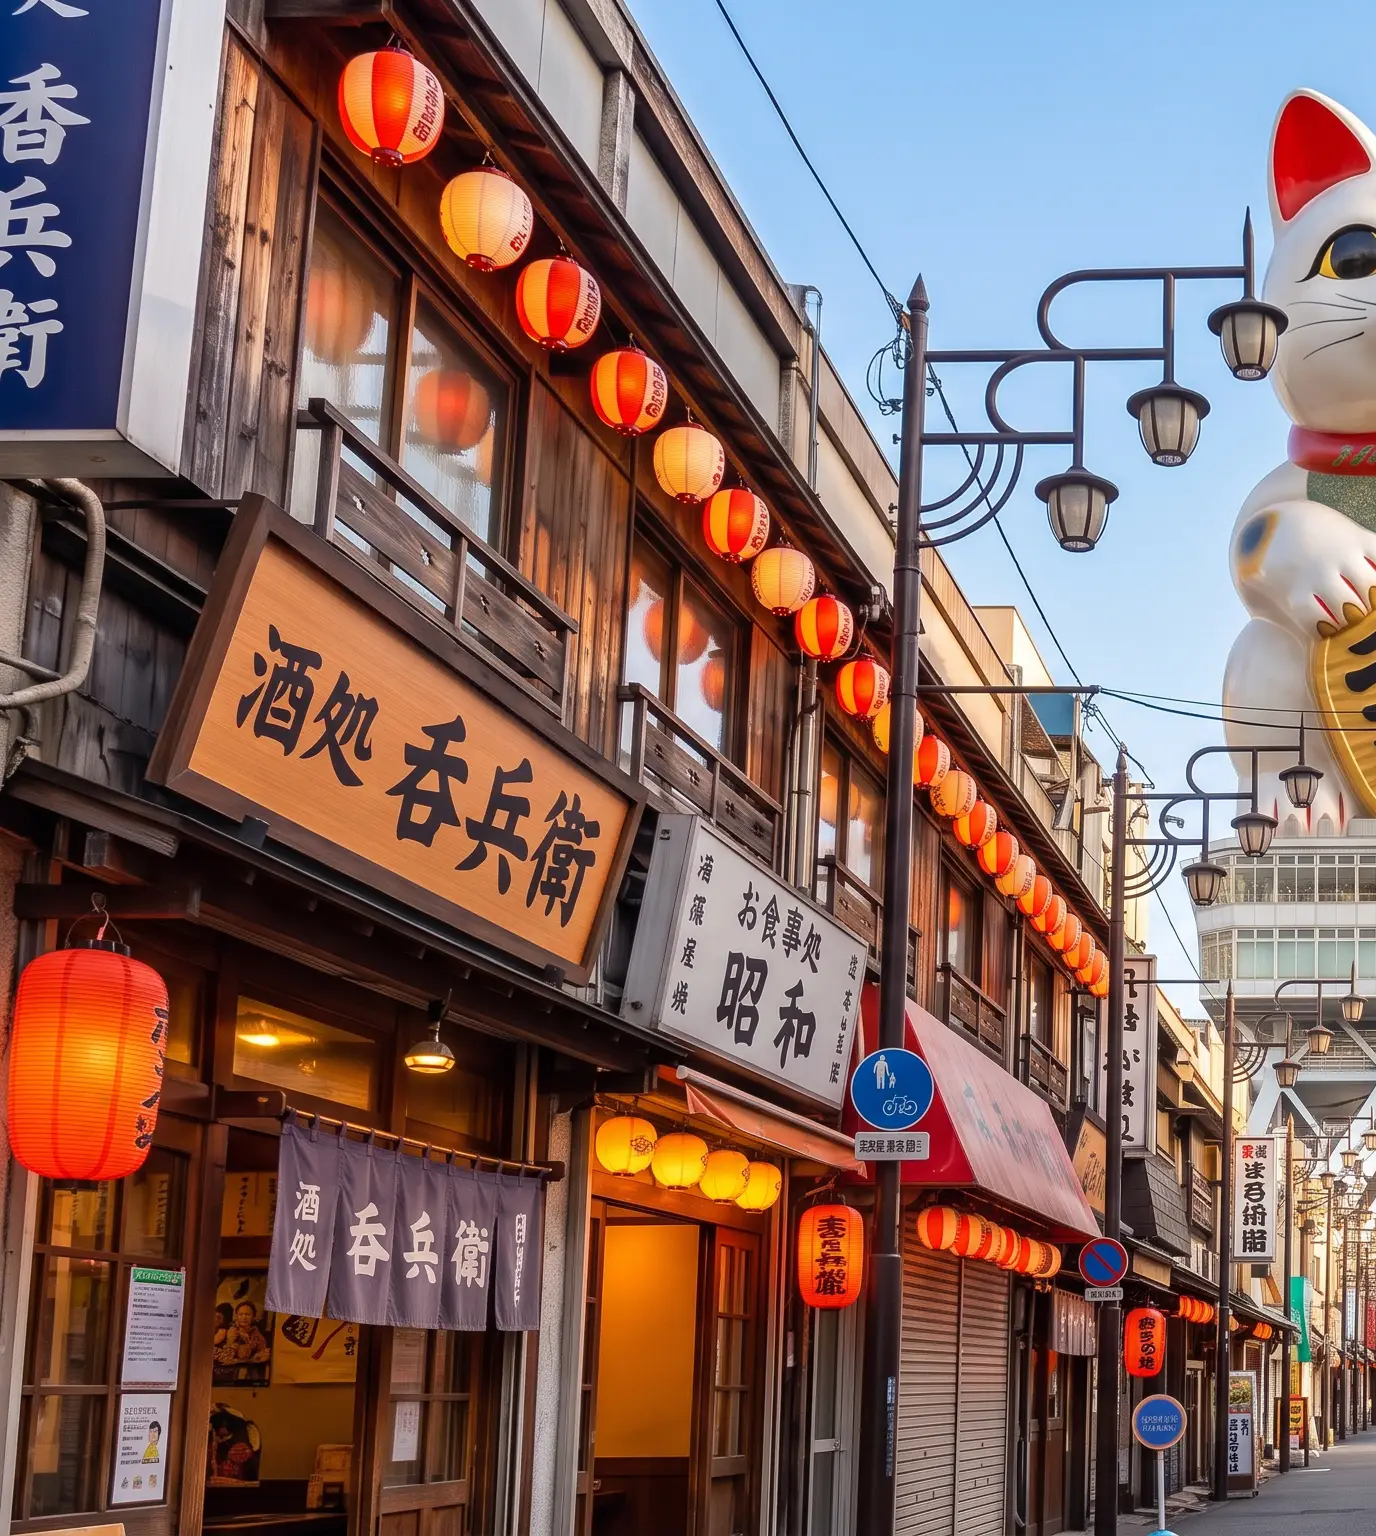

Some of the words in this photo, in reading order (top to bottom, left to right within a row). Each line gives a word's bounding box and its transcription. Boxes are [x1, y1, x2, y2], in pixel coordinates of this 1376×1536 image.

[0, 0, 91, 389] 香兵衛
[236, 624, 379, 787] 酒処
[385, 714, 601, 928] 呑兵衛
[737, 881, 822, 974] お食事処
[716, 950, 817, 1069] 昭和
[289, 1181, 321, 1271] 酒処
